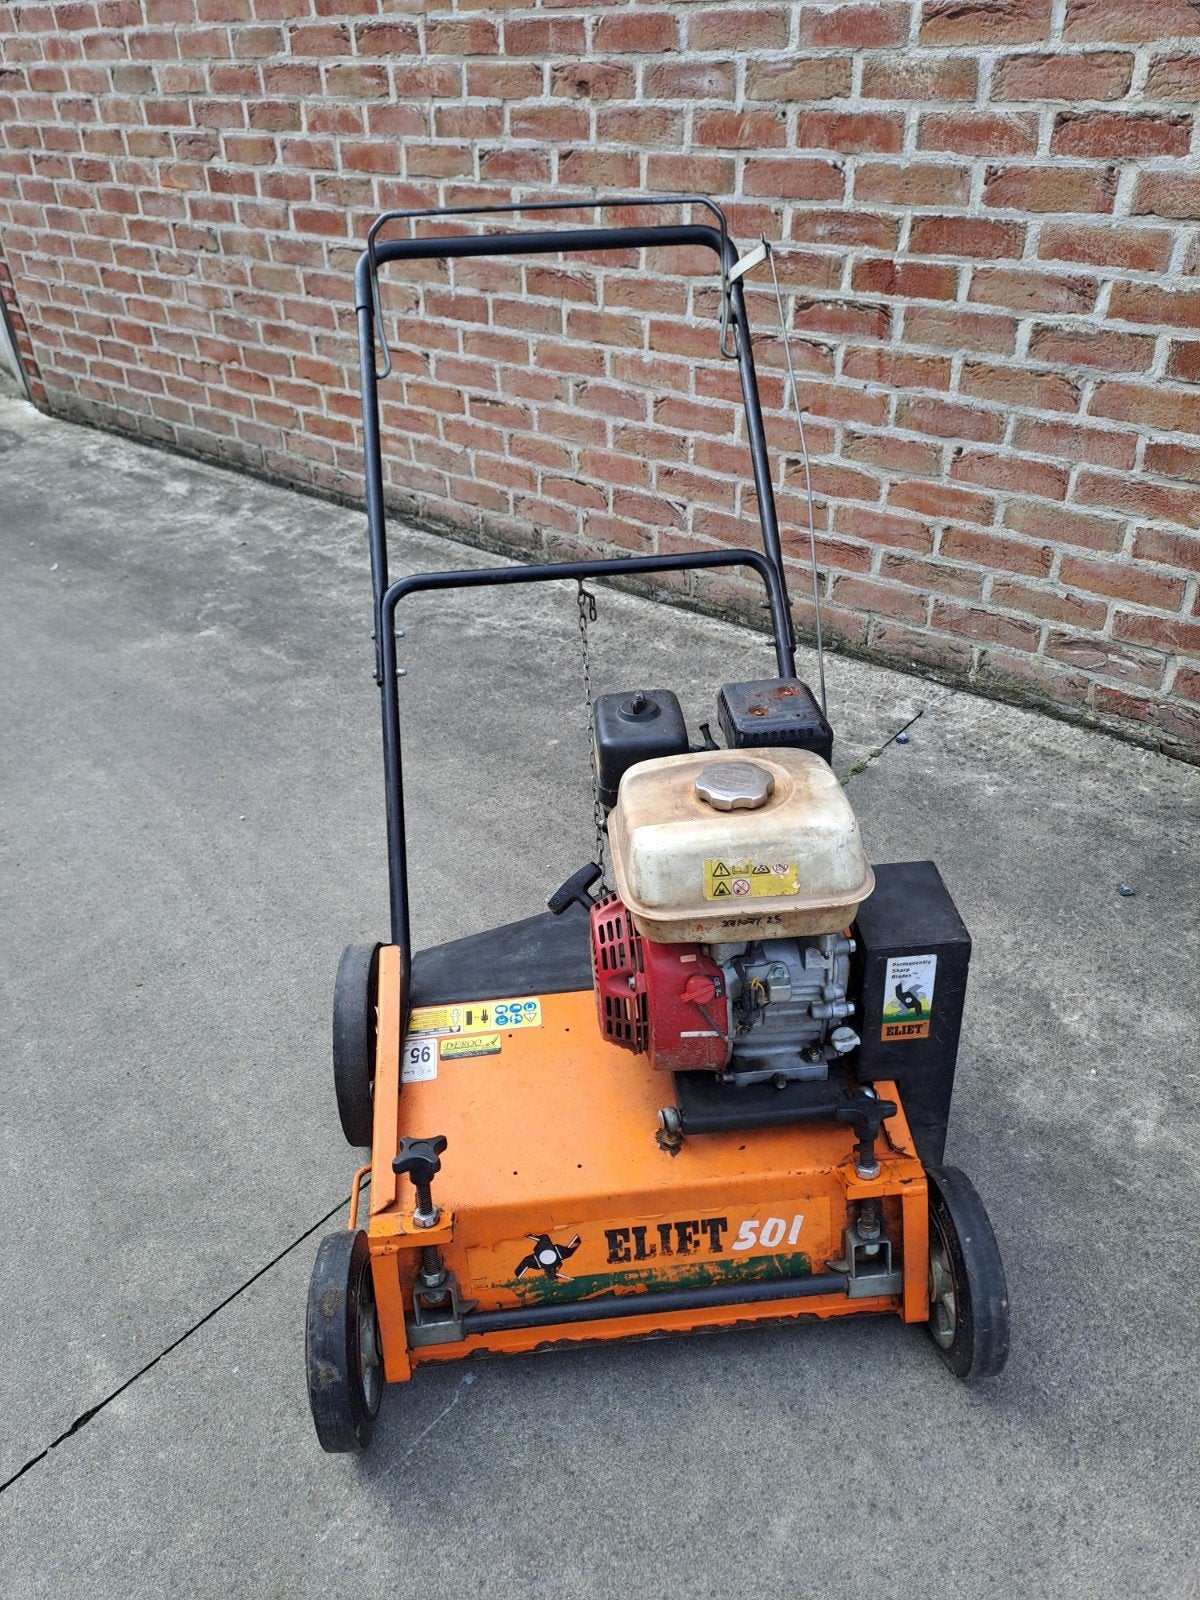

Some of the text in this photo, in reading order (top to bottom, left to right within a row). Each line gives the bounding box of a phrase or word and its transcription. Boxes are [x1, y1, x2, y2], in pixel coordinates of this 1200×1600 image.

[886, 1024, 924, 1037] ELIET
[411, 1046, 431, 1064] 95
[604, 1214, 805, 1264] ELIET 501
